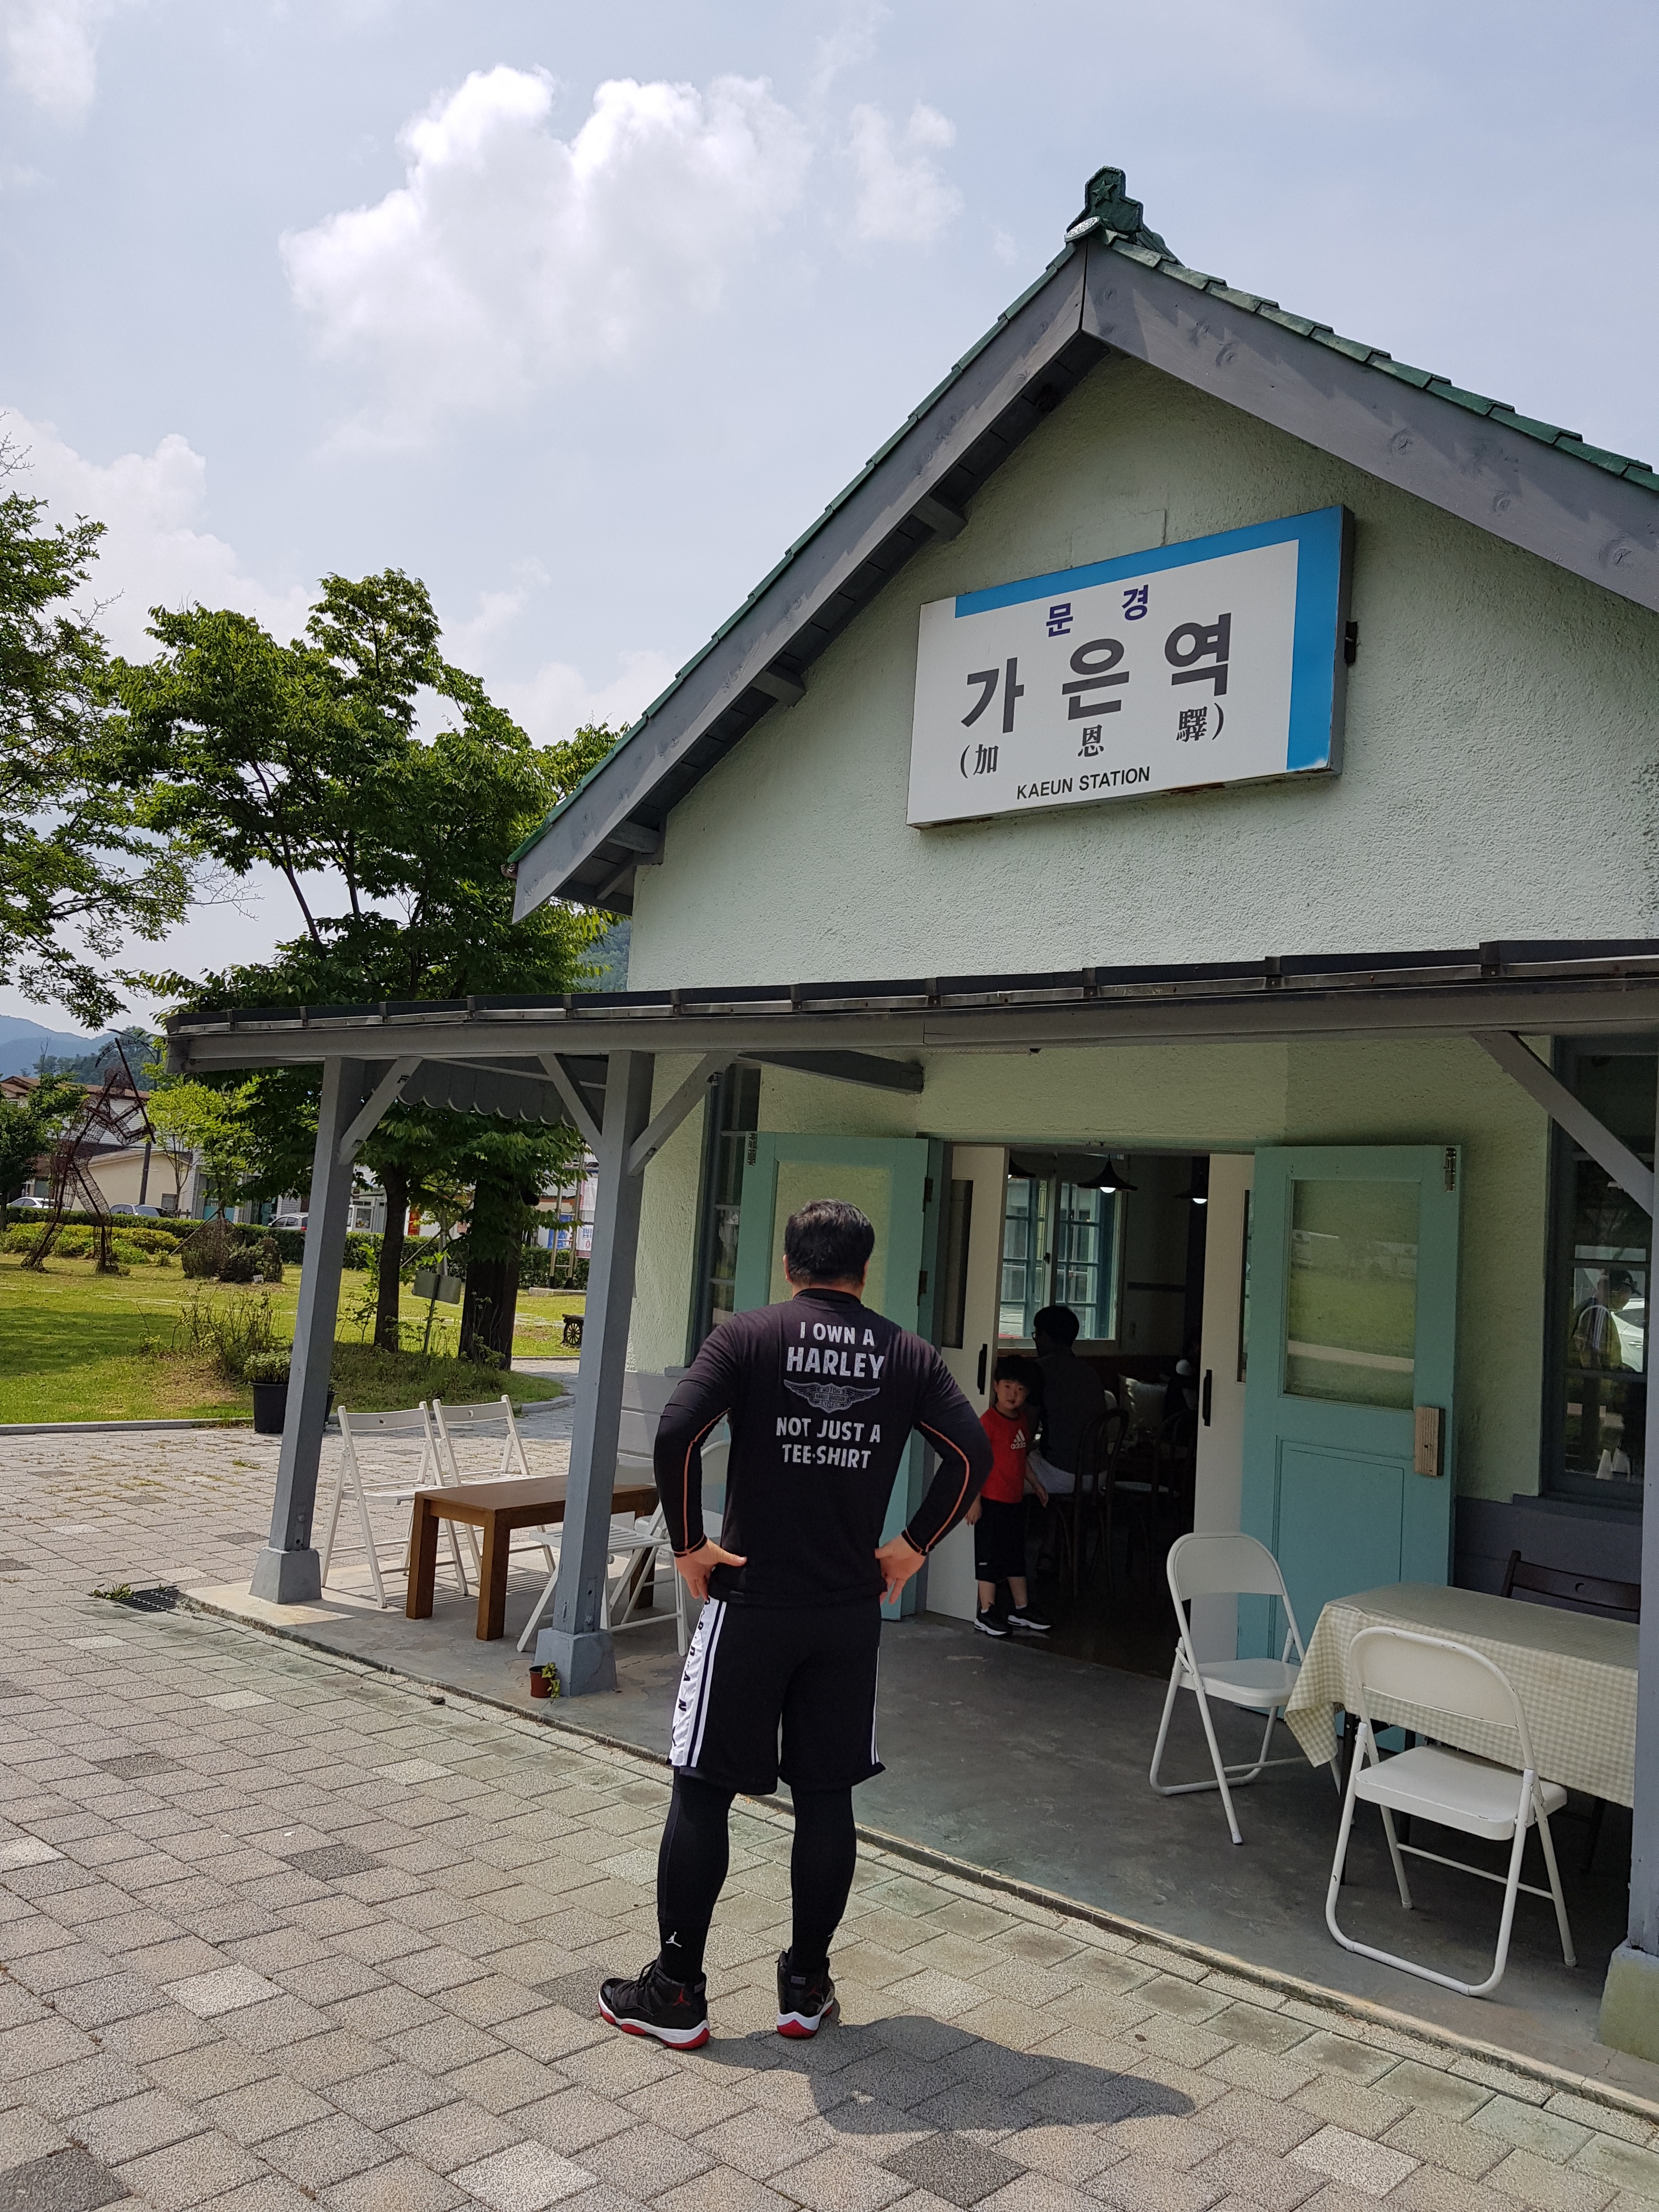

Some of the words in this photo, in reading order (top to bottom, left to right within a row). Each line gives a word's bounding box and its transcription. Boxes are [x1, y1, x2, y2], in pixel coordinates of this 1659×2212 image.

[1046, 584, 1149, 637] 문경
[961, 612, 1232, 734] 가은역
[1017, 777, 1073, 800] KAEUN
[1079, 766, 1151, 791] STATION
[800, 1322, 806, 1339] I
[813, 1323, 856, 1345] OWN
[863, 1329, 874, 1346] A
[786, 1346, 885, 1379] HARLEY
[776, 1417, 811, 1437] NOT
[816, 1419, 865, 1442] JUST
[869, 1424, 881, 1443] A
